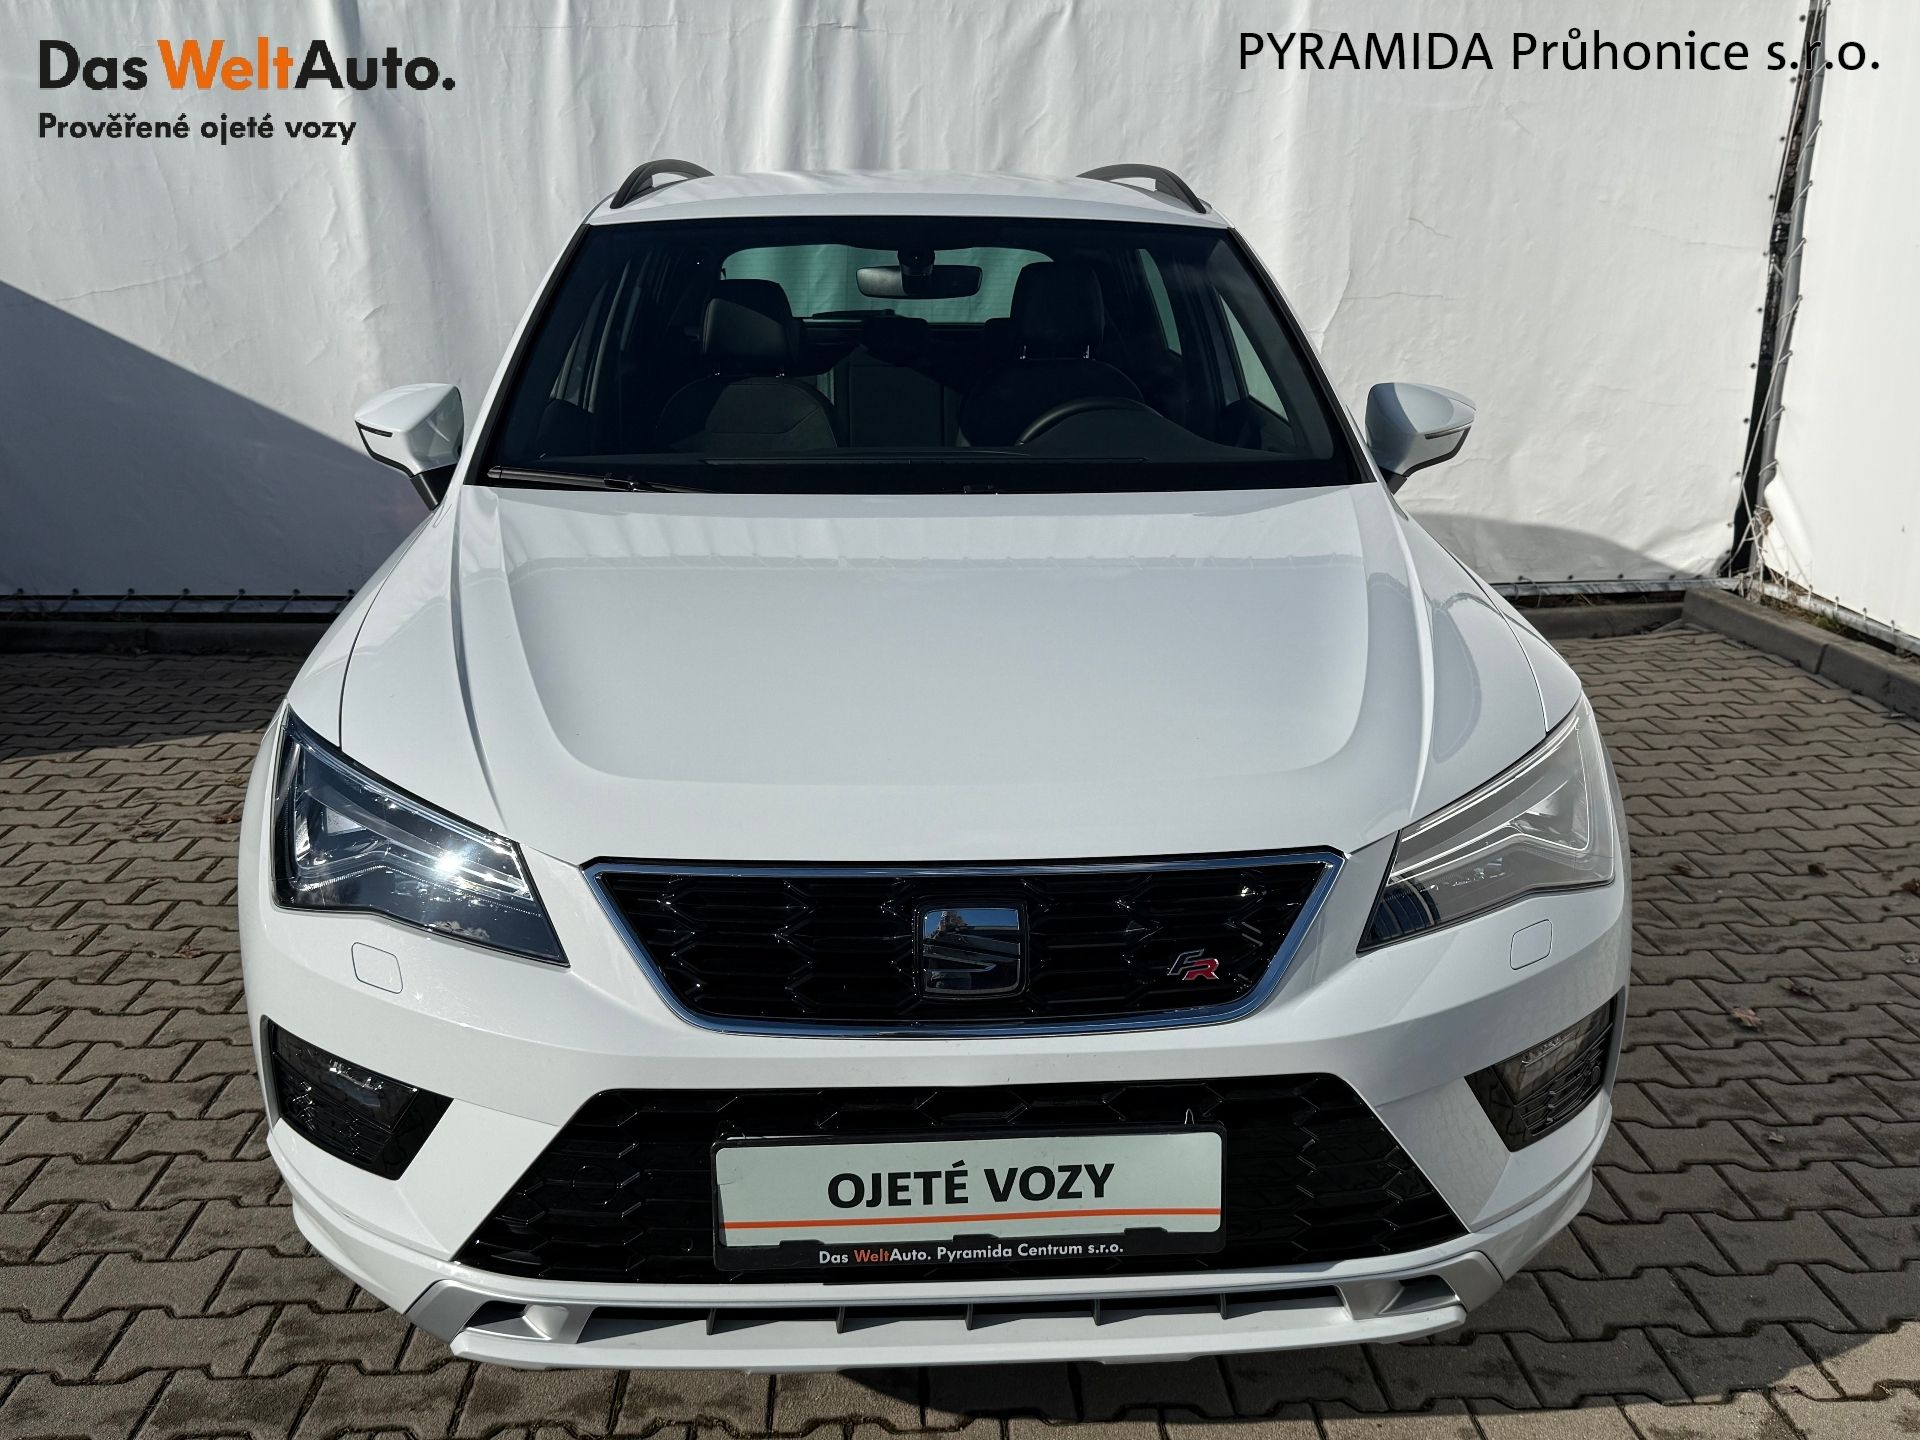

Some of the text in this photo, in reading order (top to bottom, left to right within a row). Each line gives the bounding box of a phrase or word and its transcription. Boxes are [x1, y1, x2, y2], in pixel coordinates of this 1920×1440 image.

[827, 1159, 1115, 1208] OJETÉ VOZY
[818, 1242, 1124, 1265] Das WeltAuto. Pyramida Centrum s.r.o.
